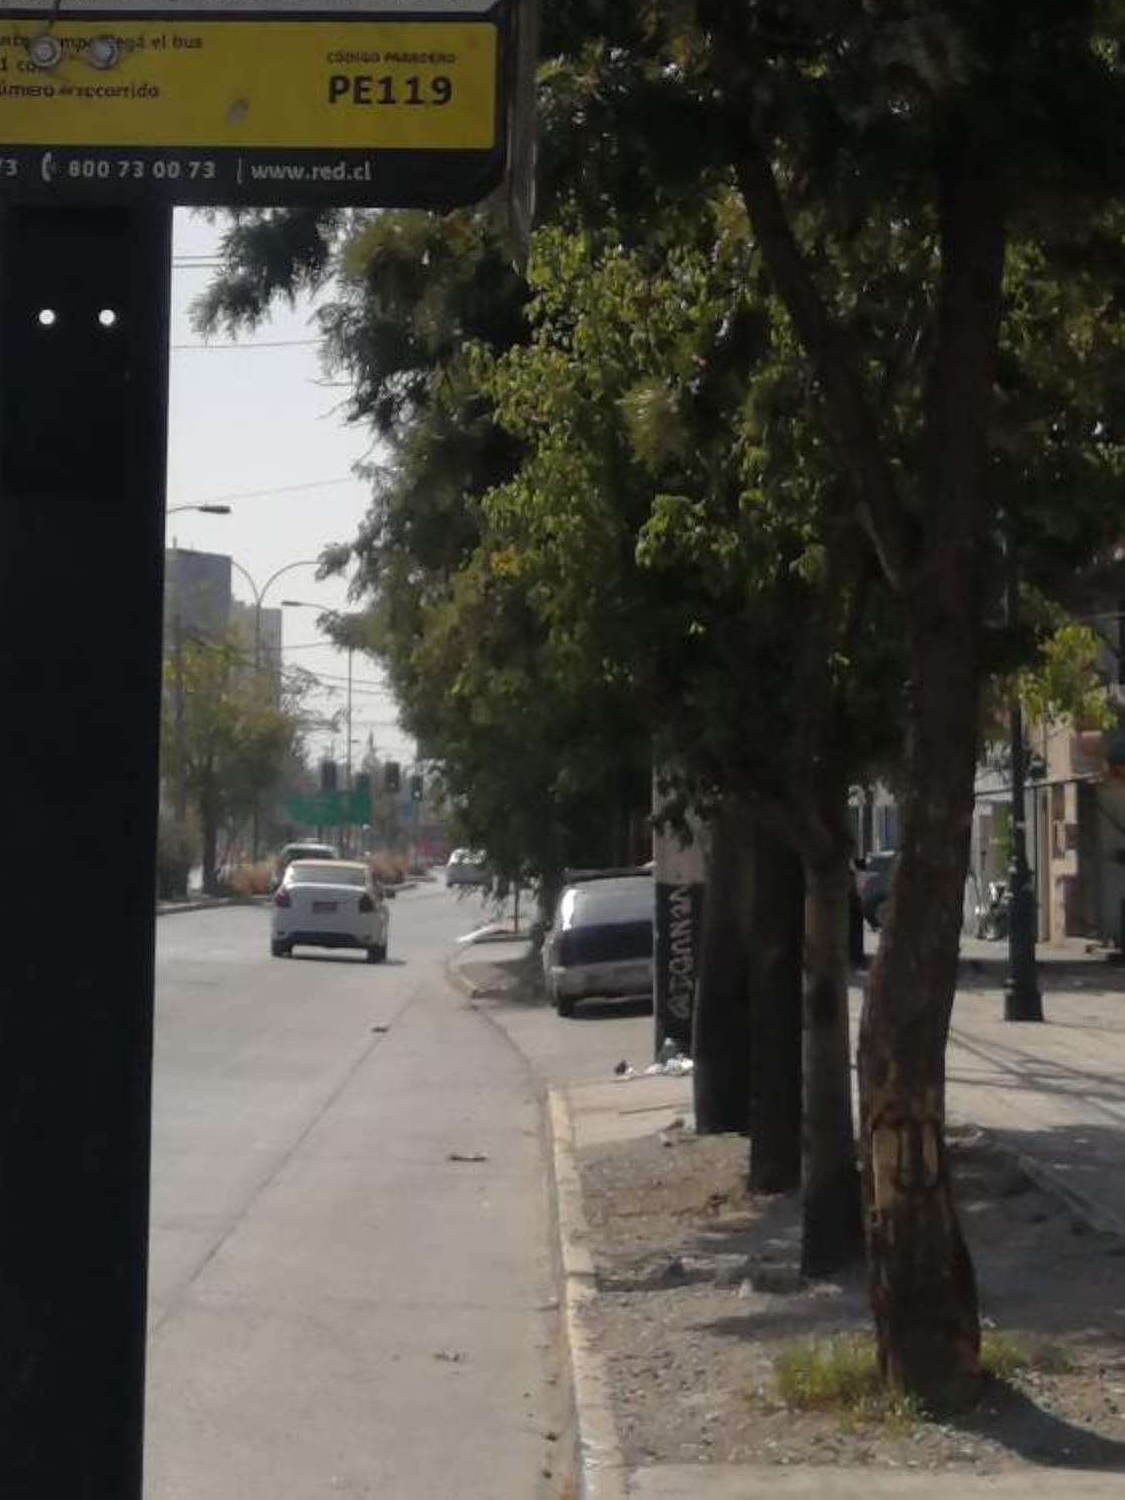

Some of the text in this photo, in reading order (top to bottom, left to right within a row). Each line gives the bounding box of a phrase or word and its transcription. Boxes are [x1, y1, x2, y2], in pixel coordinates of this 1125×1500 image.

[151, 35, 166, 49] el
[172, 35, 203, 49] bus
[75, 83, 159, 99] recorrido
[328, 75, 453, 105] PE119
[68, 160, 109, 180] 800
[118, 160, 144, 180] 73
[152, 160, 179, 180] 00
[188, 160, 216, 180] 73
[250, 160, 372, 182] www.red.cl
